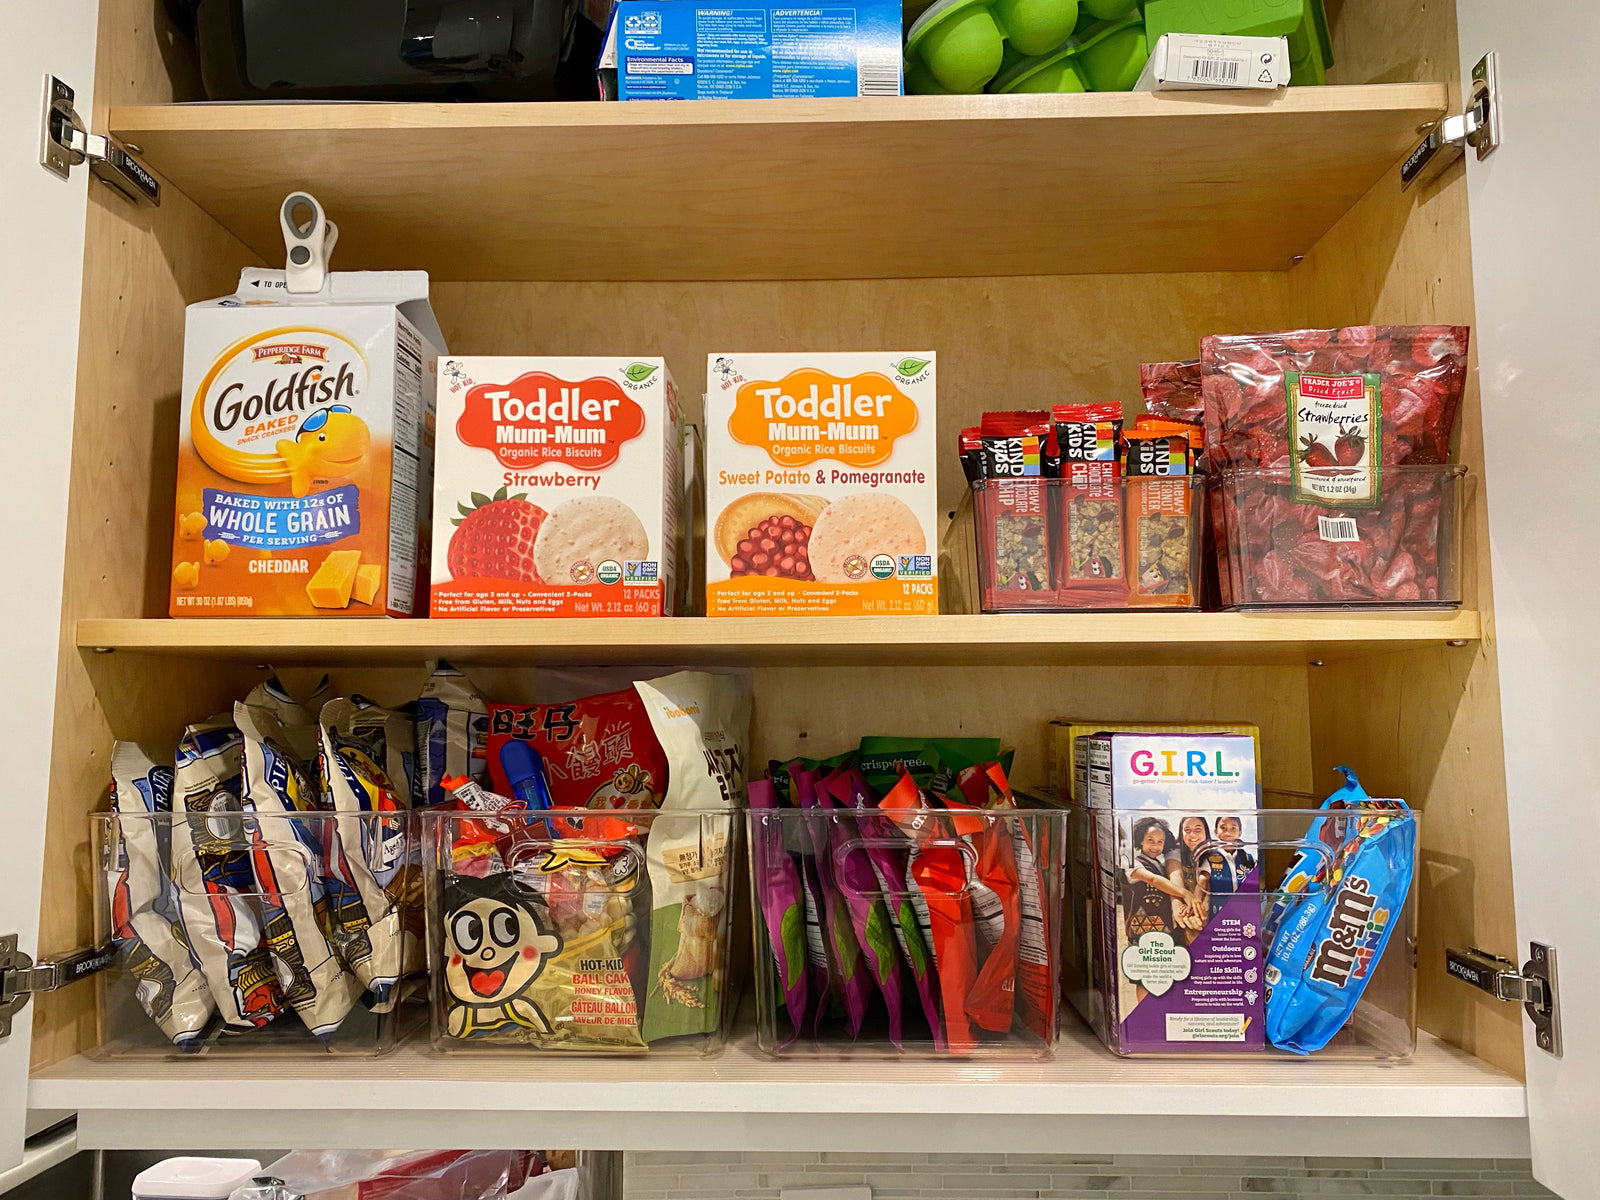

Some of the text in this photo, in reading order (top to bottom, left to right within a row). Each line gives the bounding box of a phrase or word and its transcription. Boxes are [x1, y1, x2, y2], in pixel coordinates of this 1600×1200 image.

[263, 280, 272, 288] TO
[257, 345, 322, 358] PEPPERIDGE FARM
[622, 376, 658, 391] ORGANIC
[894, 370, 931, 385] ORGANIC
[1303, 378, 1354, 387] TRADER JOE'S
[213, 361, 355, 432] Goldfish
[1308, 385, 1355, 396] Dried Fruit
[484, 387, 620, 424] Toddler
[755, 383, 893, 420] Toddler
[1298, 407, 1369, 425] Strawberries
[244, 413, 299, 437] BAKED
[768, 422, 880, 441] Mum-Mum
[236, 425, 297, 446] SNACK CRACKERS
[495, 425, 607, 444] Mum-Mum
[1081, 422, 1098, 461] KIND
[499, 446, 602, 460] Organic Rice Biscuits
[772, 443, 876, 457] Organic Rice Biscuits
[1007, 437, 1025, 477] KIND
[503, 471, 601, 490] Strawberry
[719, 469, 926, 488] Sweet Potato & Pomegranate
[214, 493, 344, 511] BAKED WITH OF
[1148, 480, 1161, 511] BUTTER
[1160, 479, 1174, 512] PEANUT
[209, 504, 351, 534] WHOLE GRAIN
[242, 534, 317, 546] PER SERVING
[248, 559, 309, 574] CHEDDAR
[623, 589, 660, 599] 12 PACKS
[902, 583, 934, 595] 12 PACKS
[176, 596, 187, 606] NET
[574, 602, 660, 616] Net Wt. 2.12 oz (60 g)
[862, 600, 875, 611] Net
[876, 600, 888, 611] Wt.
[889, 600, 902, 611] 2.12
[903, 602, 912, 611] oz
[492, 704, 581, 741] 旺仔
[1130, 749, 1240, 777] G.I.R.L.
[1274, 941, 1285, 958] NET
[1281, 930, 1291, 943] WT
[1281, 941, 1296, 963] 10.10
[1291, 931, 1301, 945] OZ
[580, 959, 624, 971] HOT-KID
[572, 972, 630, 985] BALL CAK
[574, 987, 634, 996] HONEY FLAVOR
[1184, 988, 1243, 996] Entrepreneurship
[571, 998, 637, 1014] GÂTEAU BALLON
[572, 1016, 637, 1026] AVEUR DE MIEL
